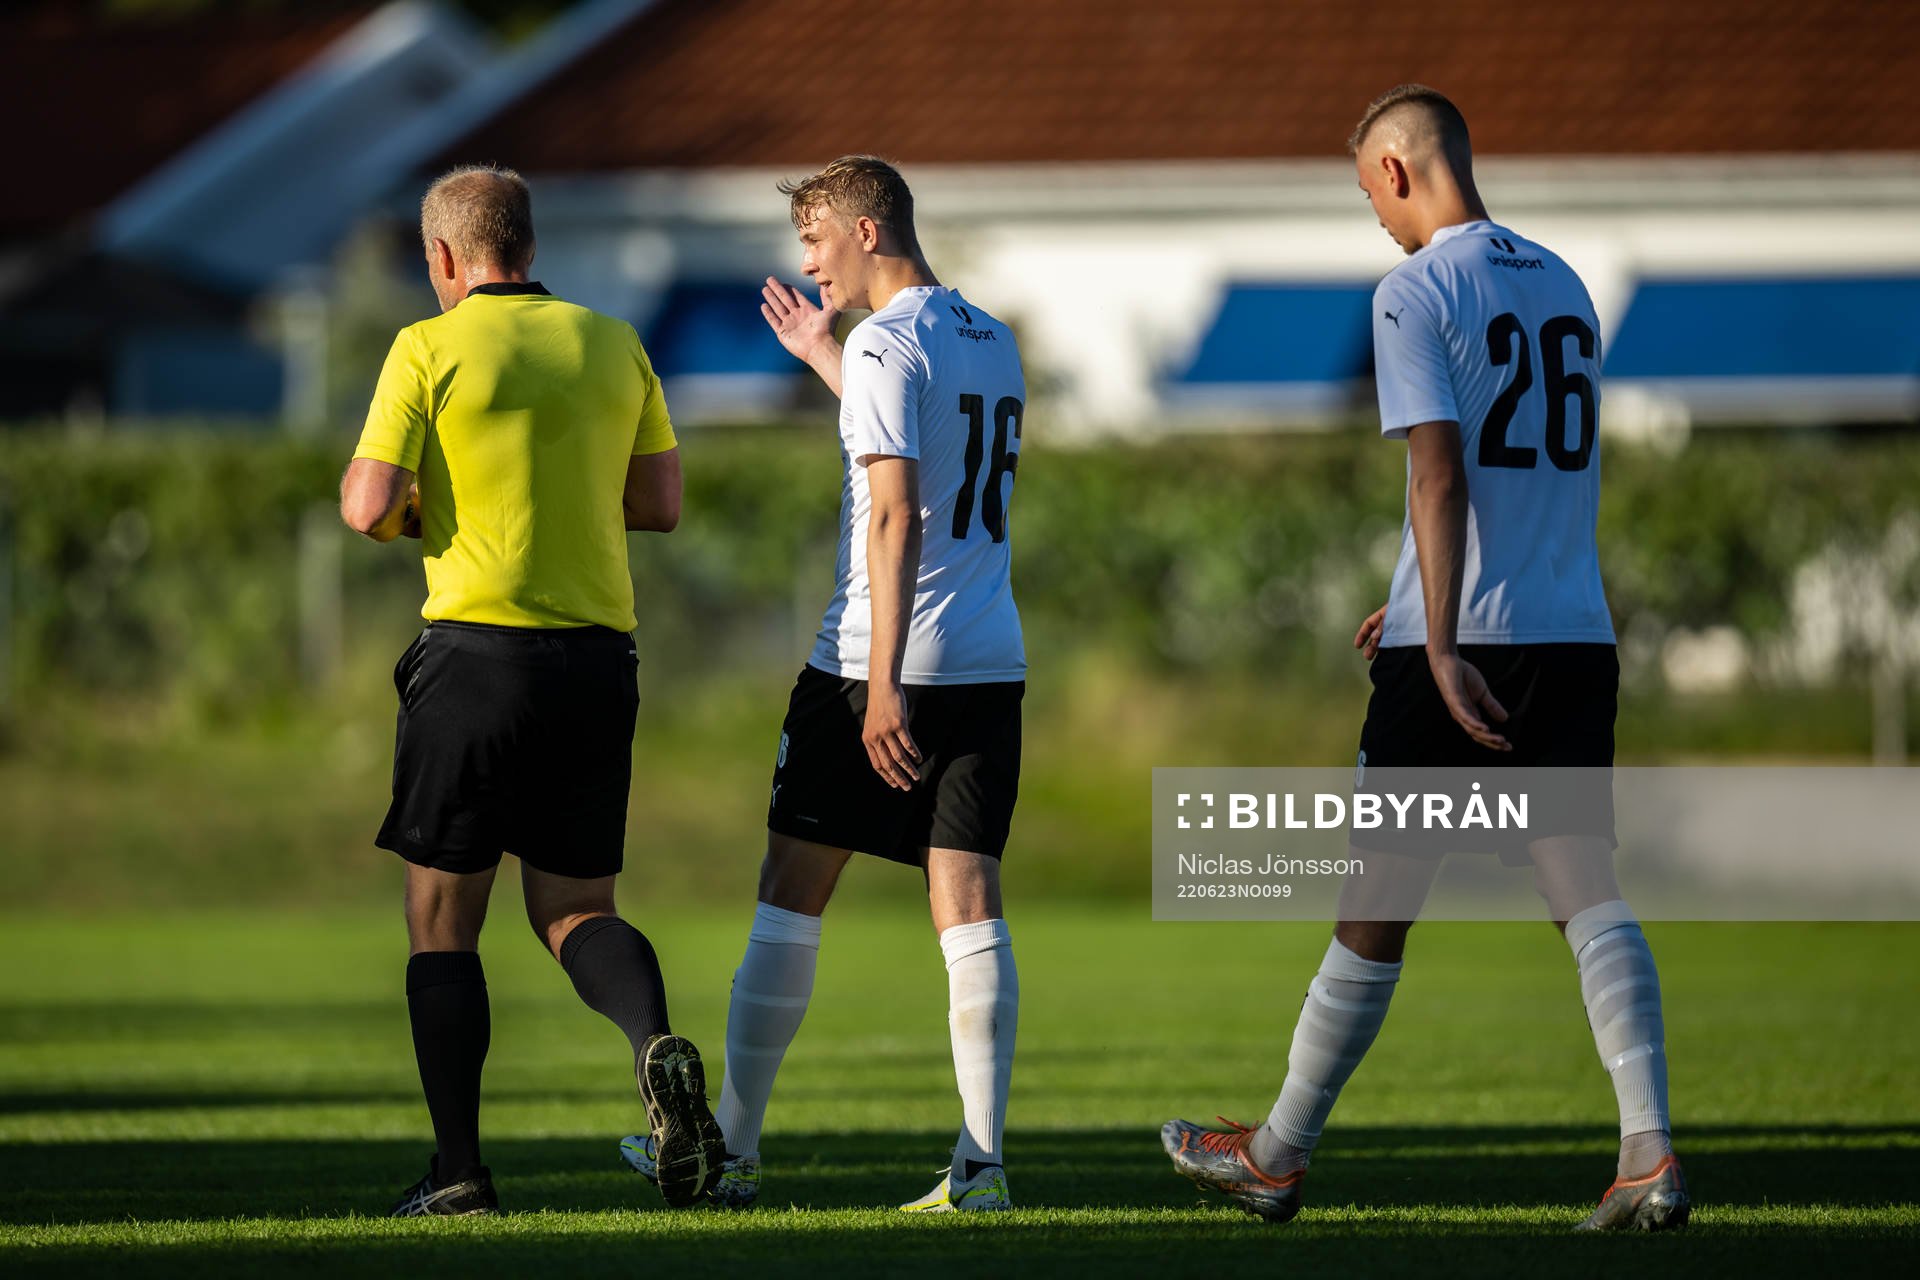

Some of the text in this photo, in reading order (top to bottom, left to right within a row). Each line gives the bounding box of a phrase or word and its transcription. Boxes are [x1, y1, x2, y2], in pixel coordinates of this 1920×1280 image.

[1487, 255, 1544, 271] unisport
[955, 325, 996, 343] unisport
[1479, 312, 1595, 471] 26
[952, 393, 1023, 543] 16
